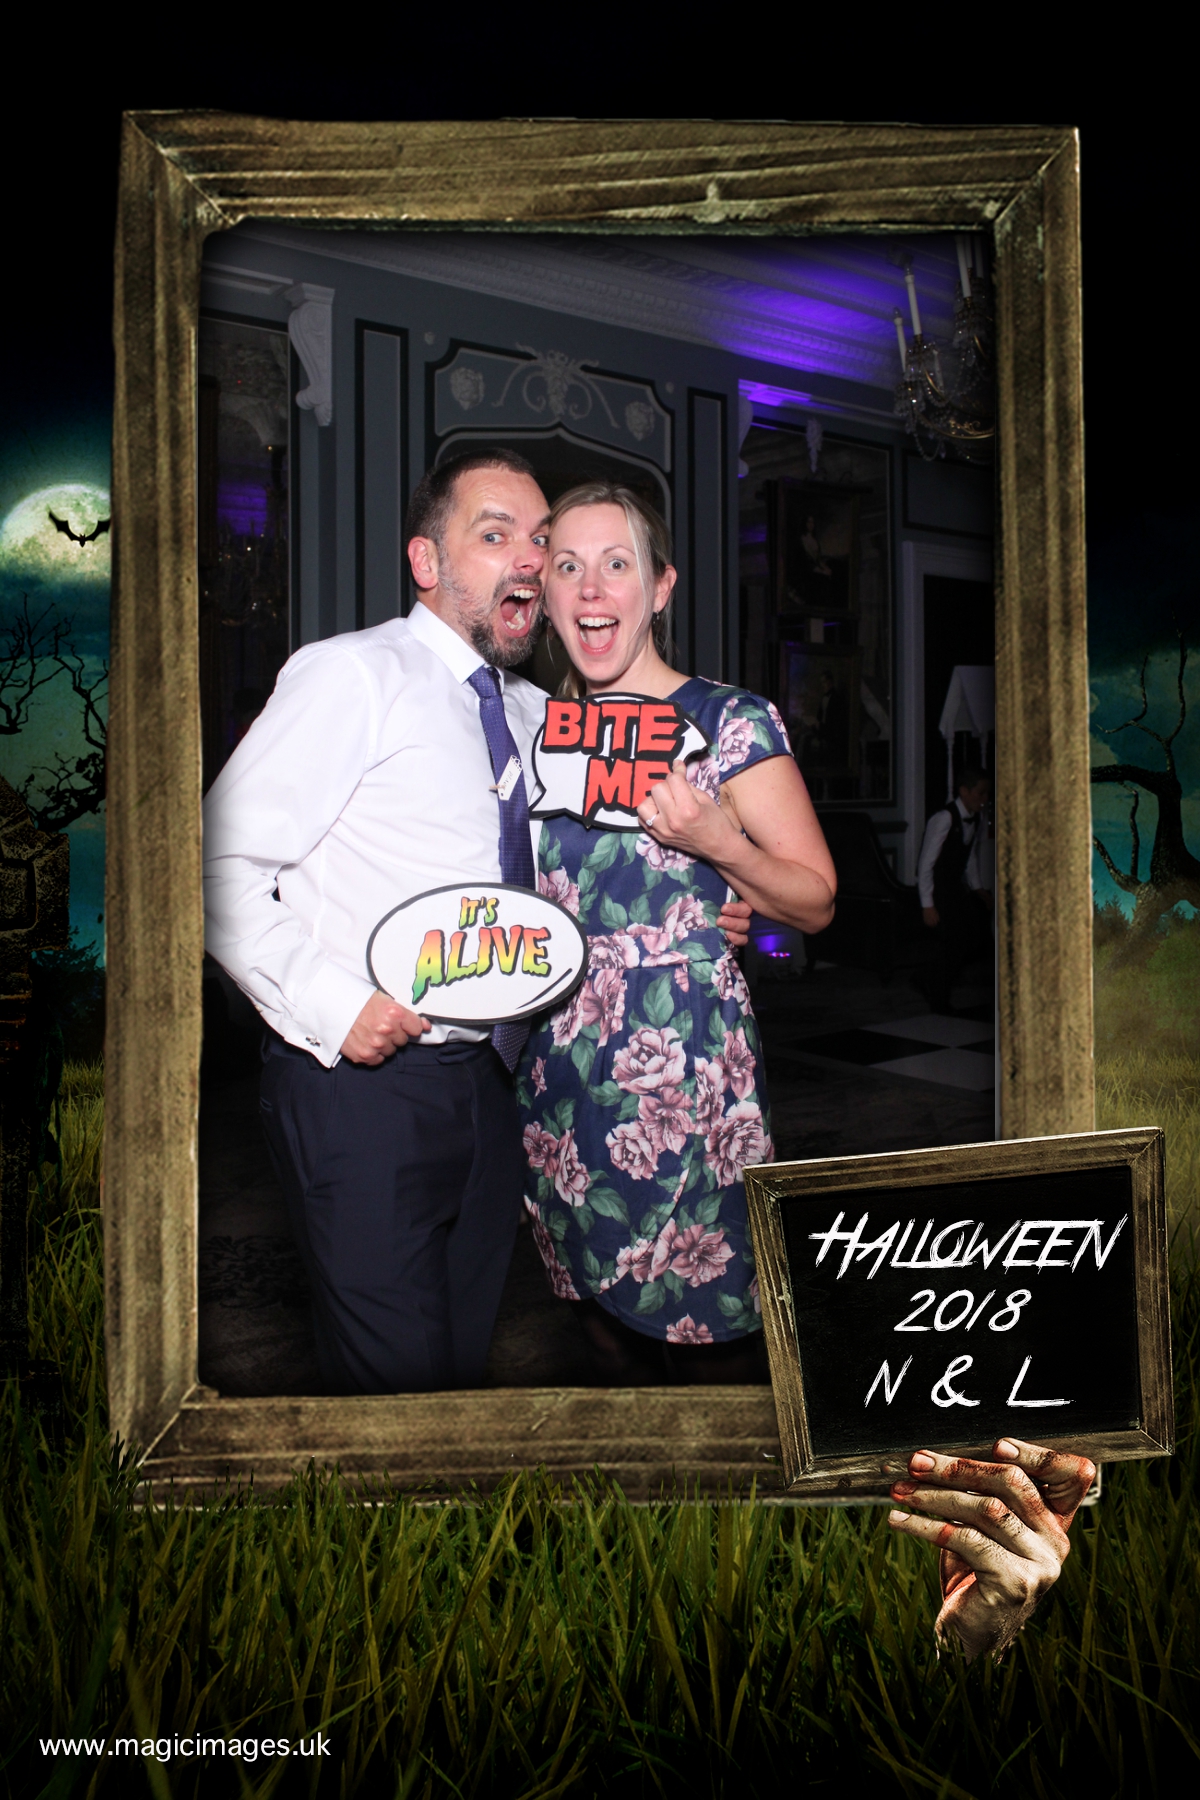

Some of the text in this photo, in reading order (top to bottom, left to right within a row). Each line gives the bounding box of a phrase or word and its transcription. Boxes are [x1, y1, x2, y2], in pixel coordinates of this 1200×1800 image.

[542, 699, 682, 754] BITE
[584, 757, 674, 817] ME
[458, 896, 500, 930] IT'S
[412, 925, 553, 1005] ALIVE
